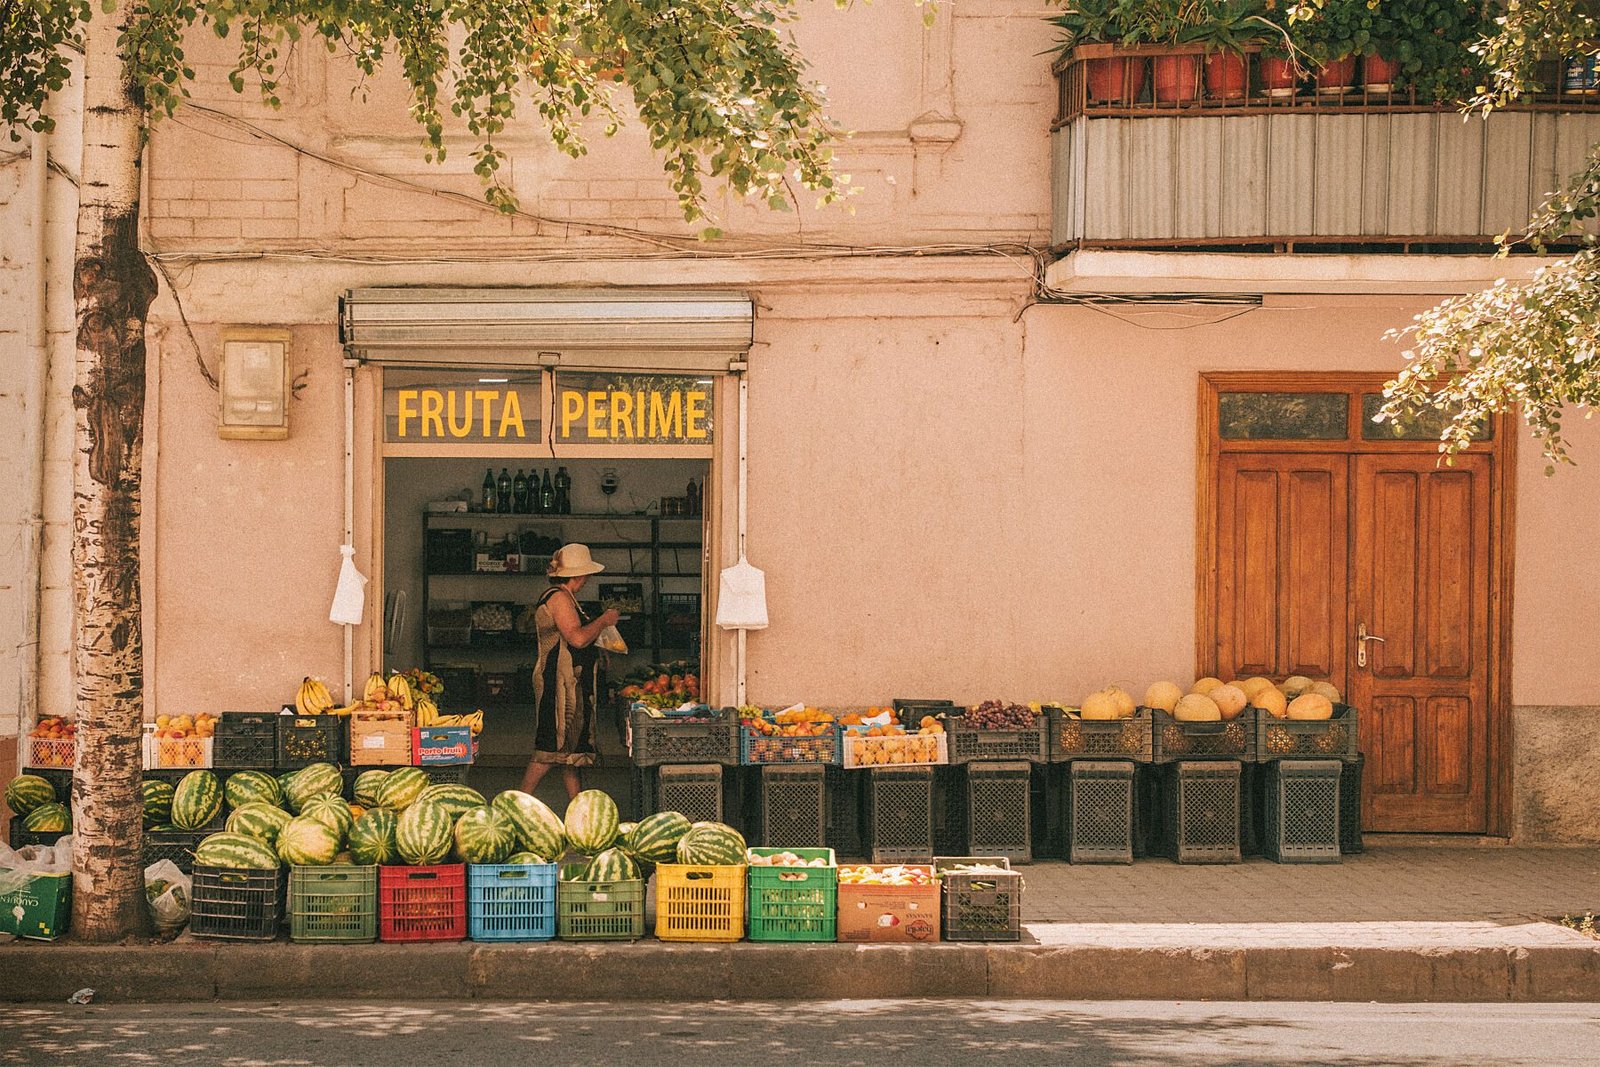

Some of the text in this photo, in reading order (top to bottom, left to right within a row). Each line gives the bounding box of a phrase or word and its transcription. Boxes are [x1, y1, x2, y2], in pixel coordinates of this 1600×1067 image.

[398, 390, 707, 439] FRUTA PERIME
[418, 747, 442, 756] Porto
